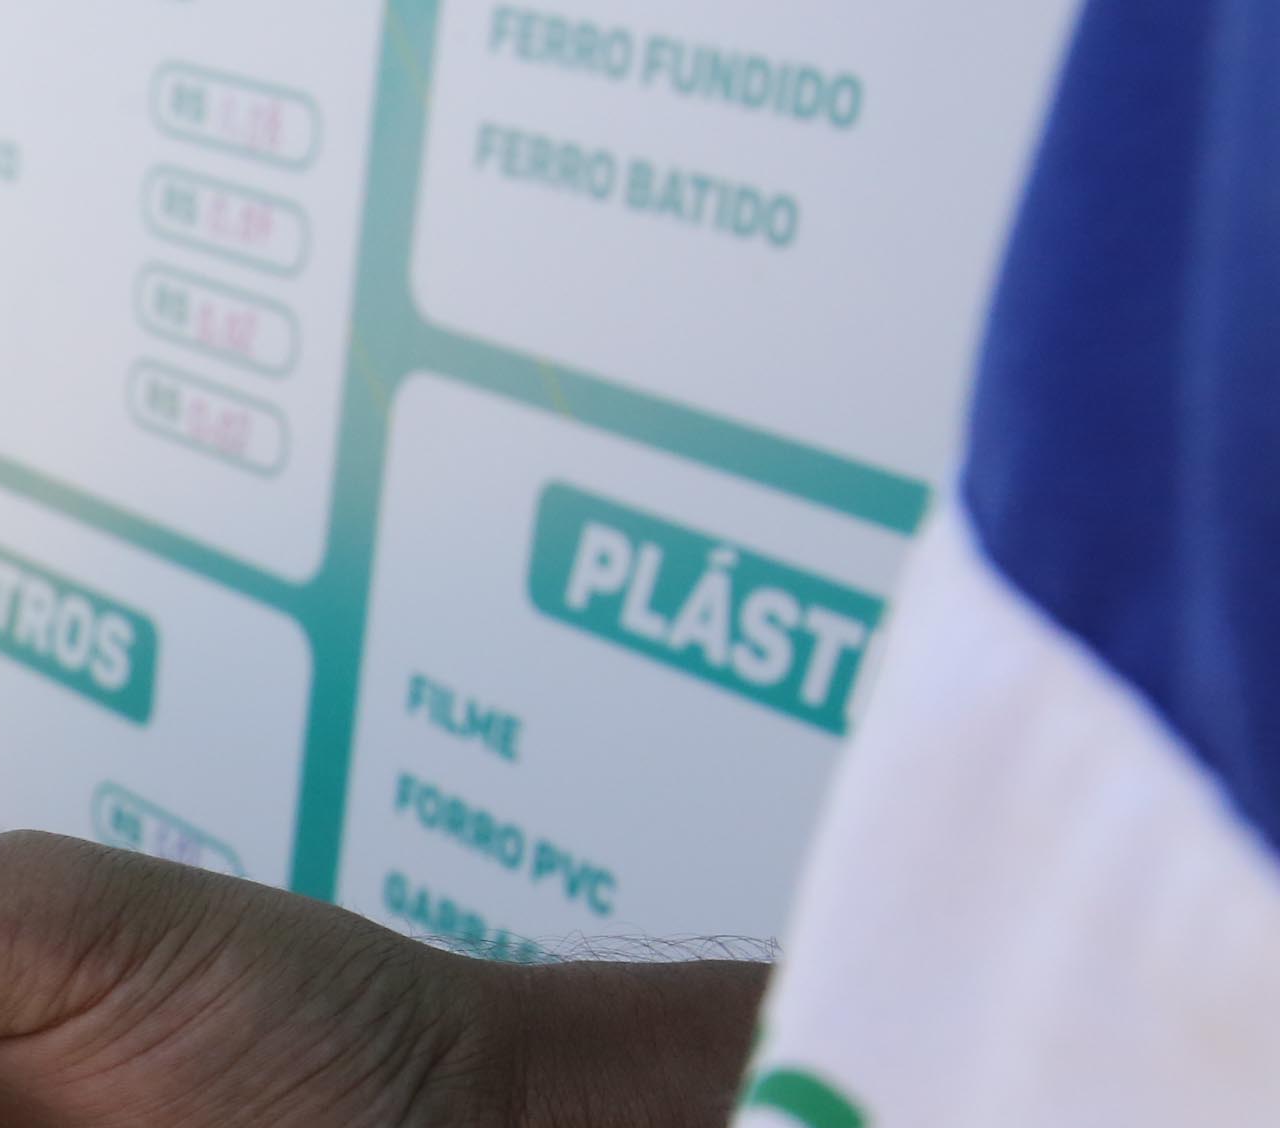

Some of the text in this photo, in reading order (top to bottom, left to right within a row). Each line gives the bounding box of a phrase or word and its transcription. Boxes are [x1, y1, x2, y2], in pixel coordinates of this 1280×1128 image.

[488, 5, 864, 130] FERRO FUNDIDO
[474, 123, 798, 250] FERRO BATIDO
[407, 672, 524, 763] FILME
[394, 772, 618, 918] FORRO PVC
